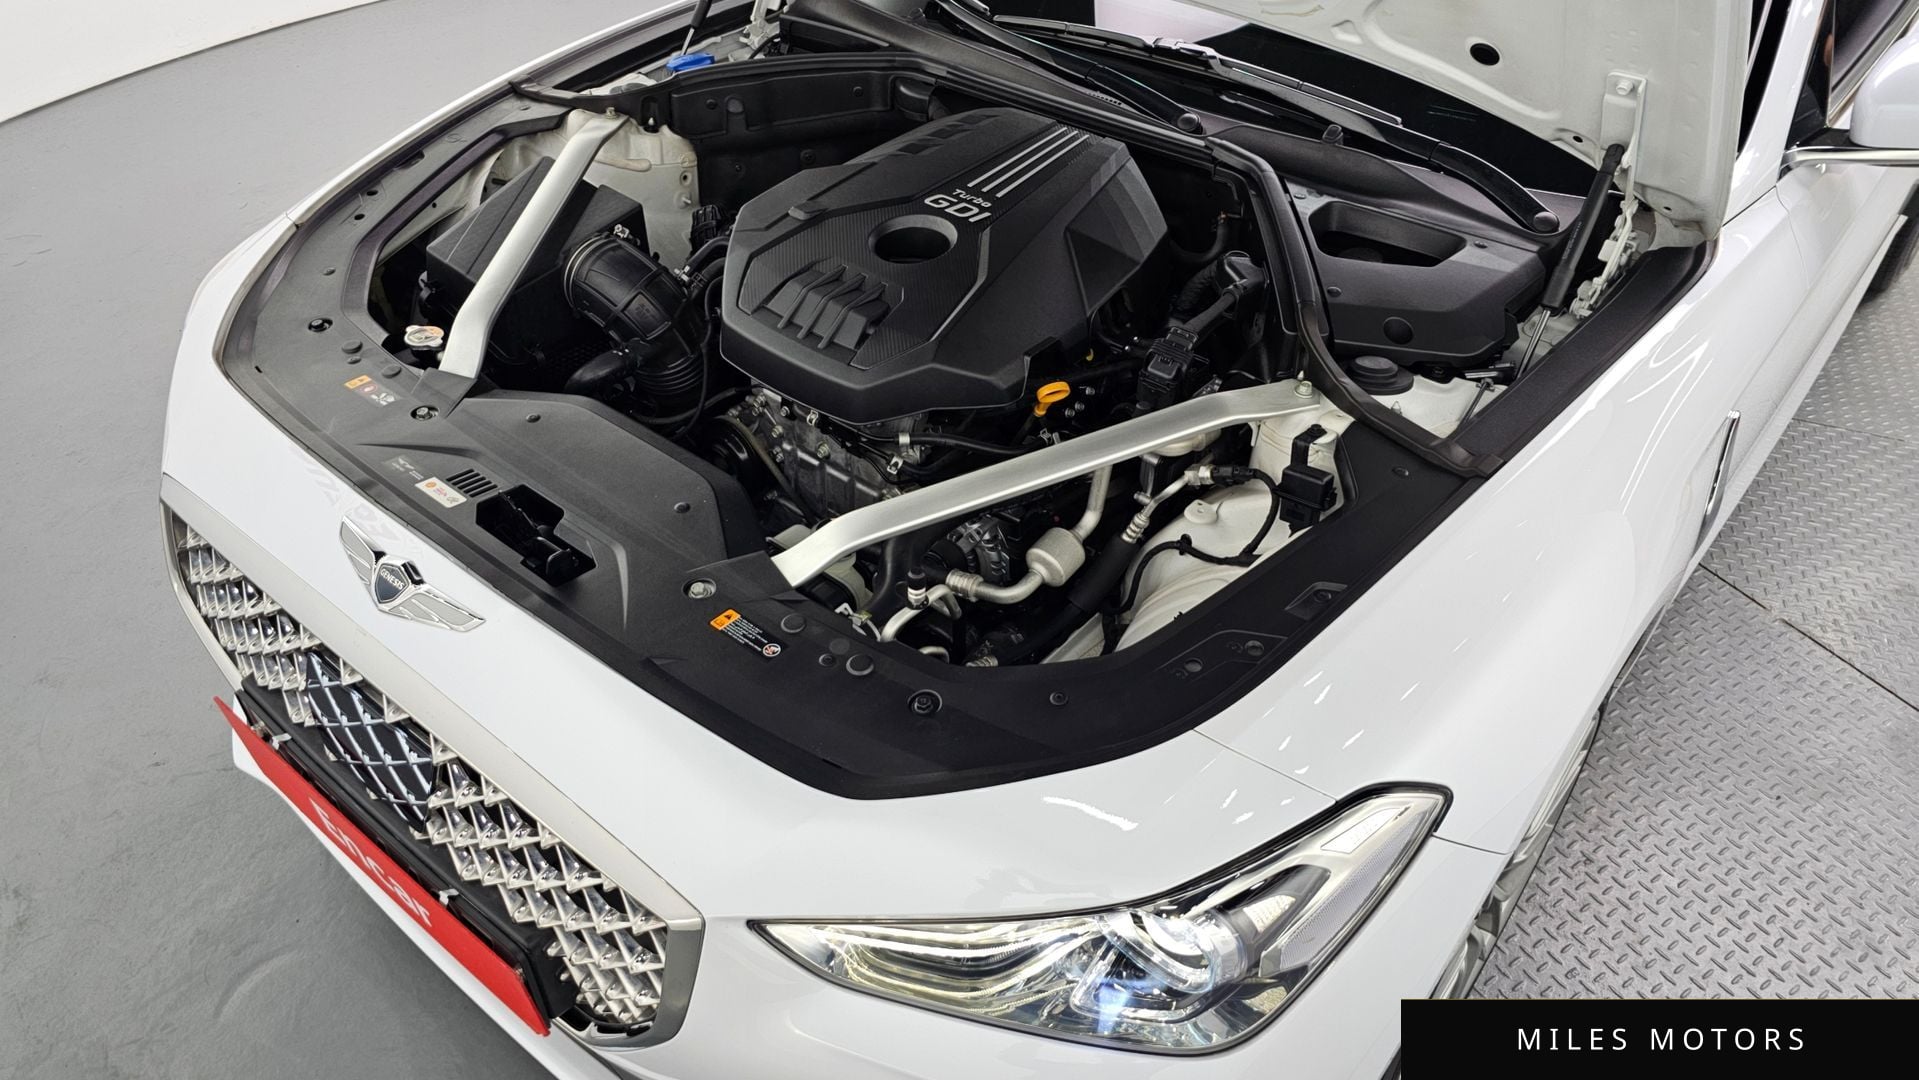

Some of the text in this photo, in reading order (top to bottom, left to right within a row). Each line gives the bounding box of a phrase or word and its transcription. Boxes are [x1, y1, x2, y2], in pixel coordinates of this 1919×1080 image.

[924, 194, 992, 223] GDI
[952, 189, 992, 208] Turbo
[380, 568, 405, 590] GENESIS
[308, 797, 433, 928] Encar
